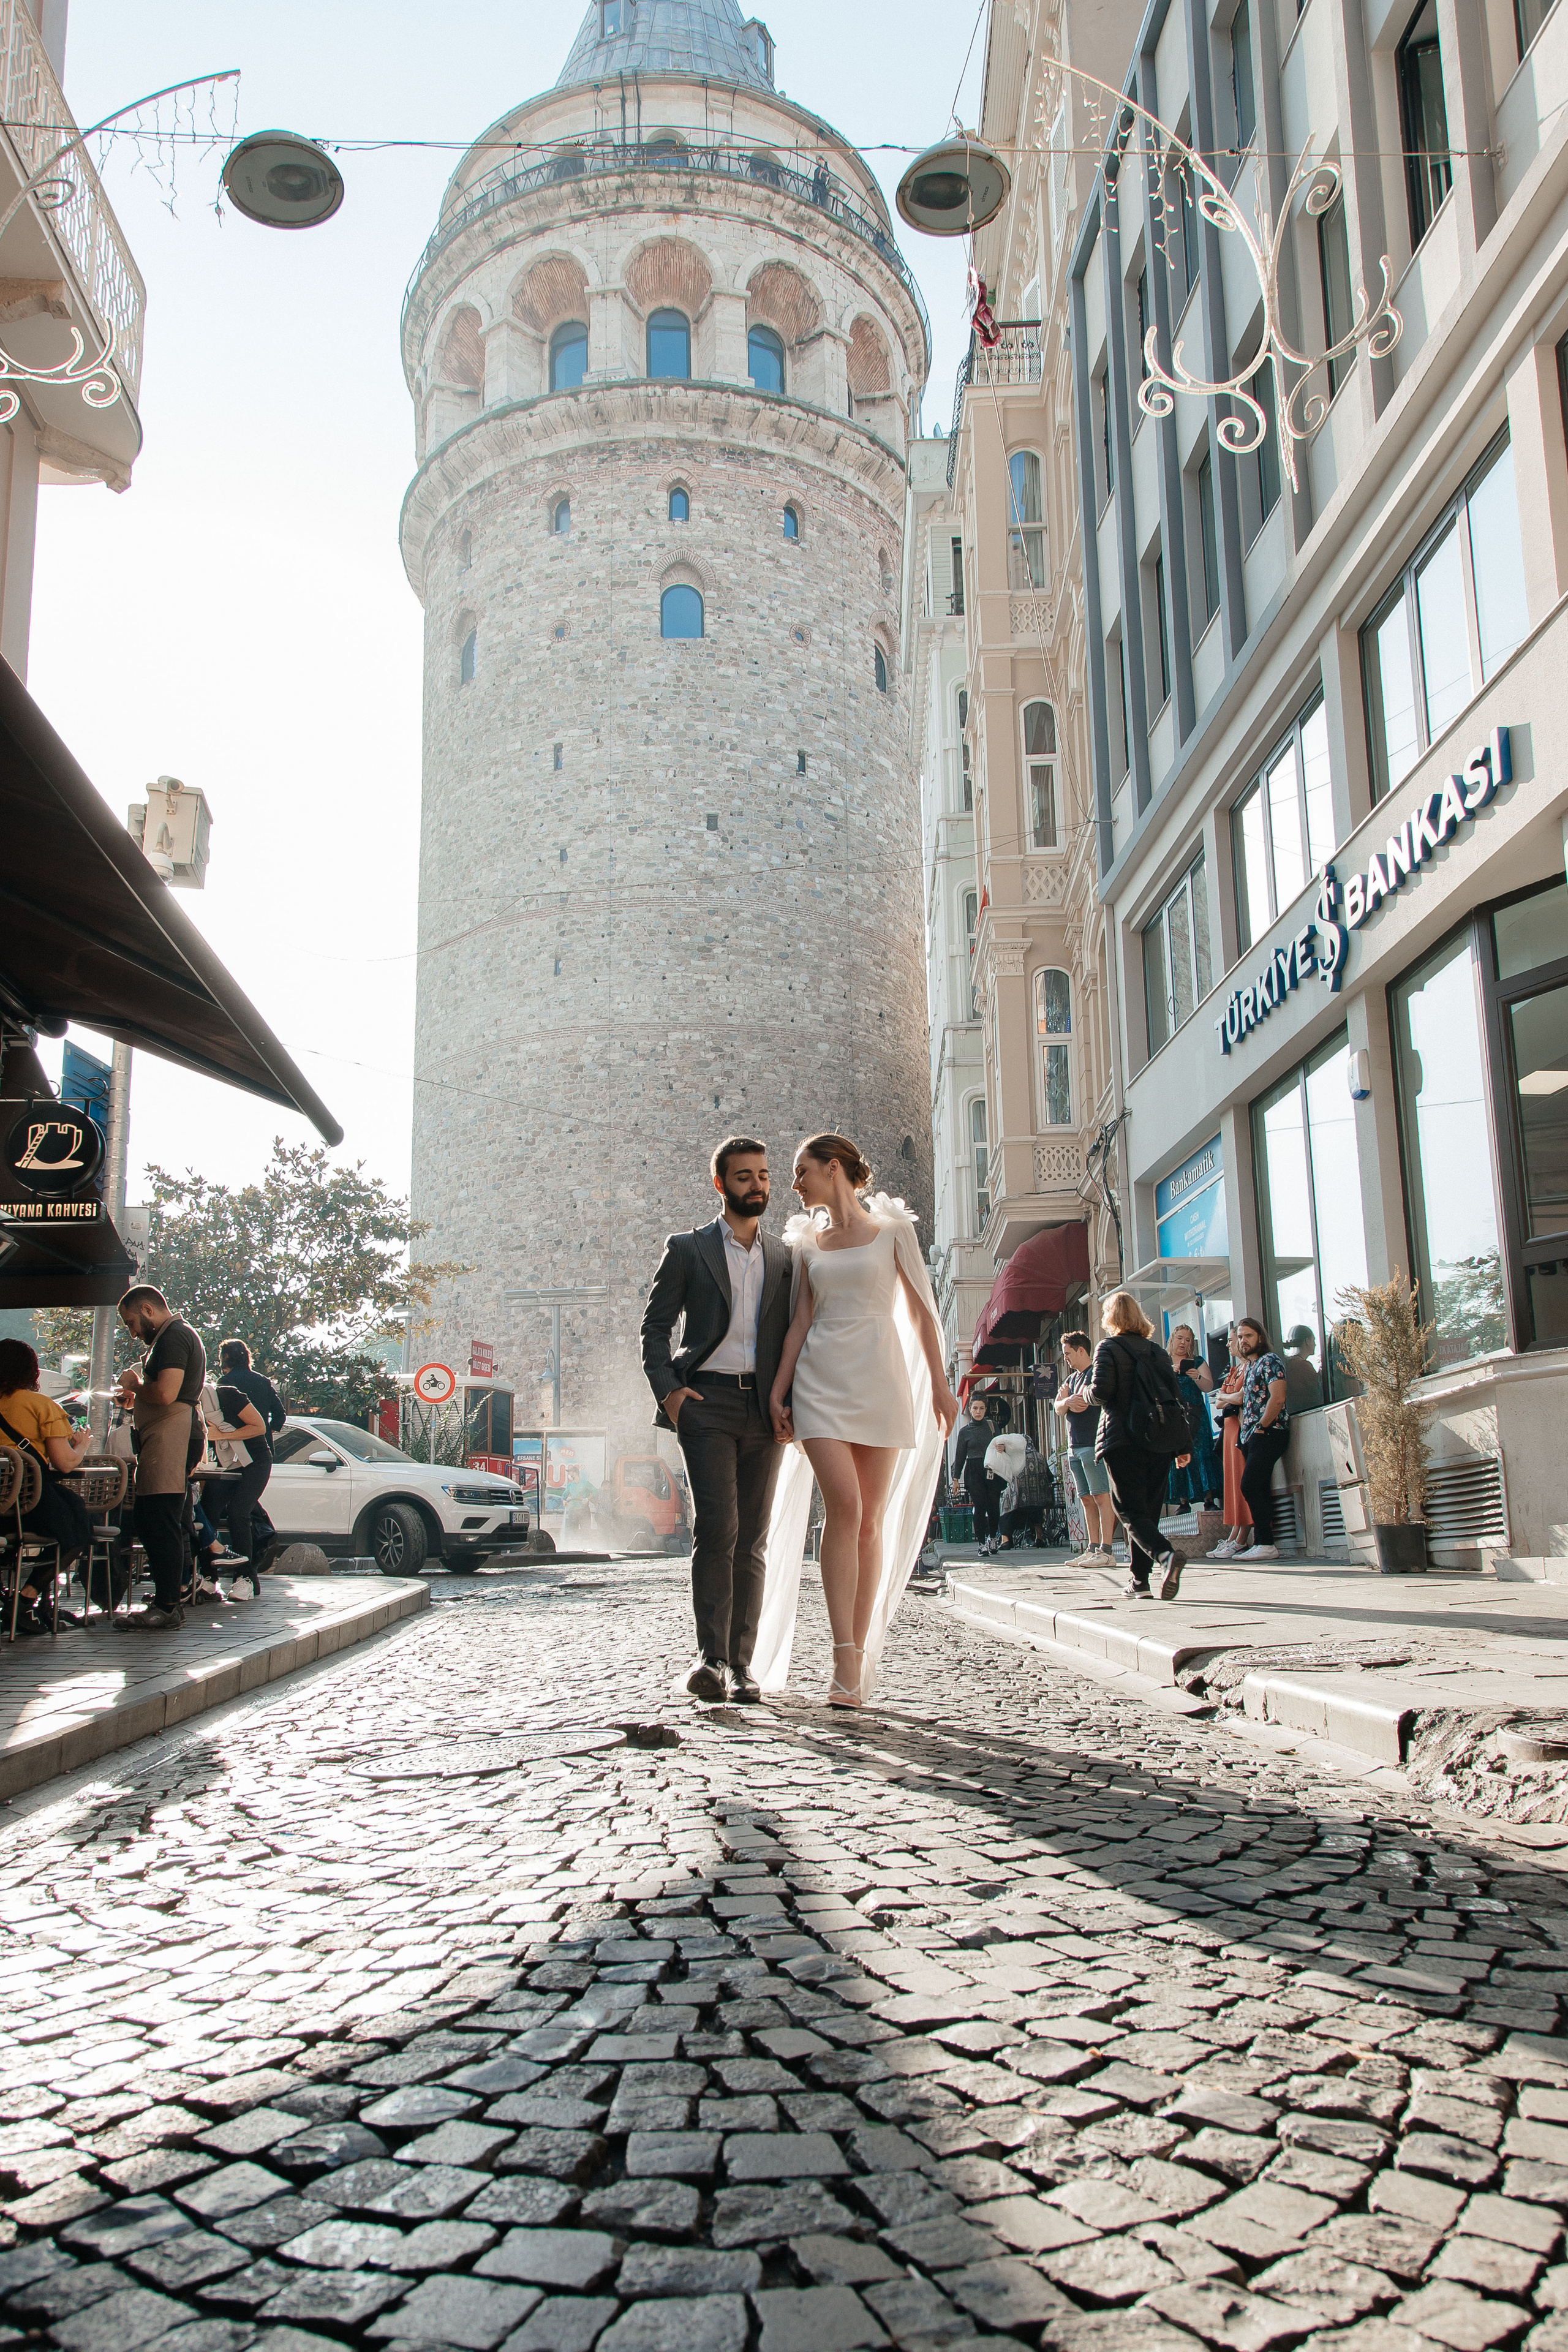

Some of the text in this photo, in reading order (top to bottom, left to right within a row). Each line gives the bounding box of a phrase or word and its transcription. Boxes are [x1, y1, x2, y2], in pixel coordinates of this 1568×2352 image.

[1213, 924, 1317, 1055] TÜRKİYE
[1343, 726, 1510, 931] BANKASI
[1169, 1150, 1215, 1200] Bankamatik
[1189, 1210, 1199, 1224] CASH
[472, 1461, 486, 1472] 34
